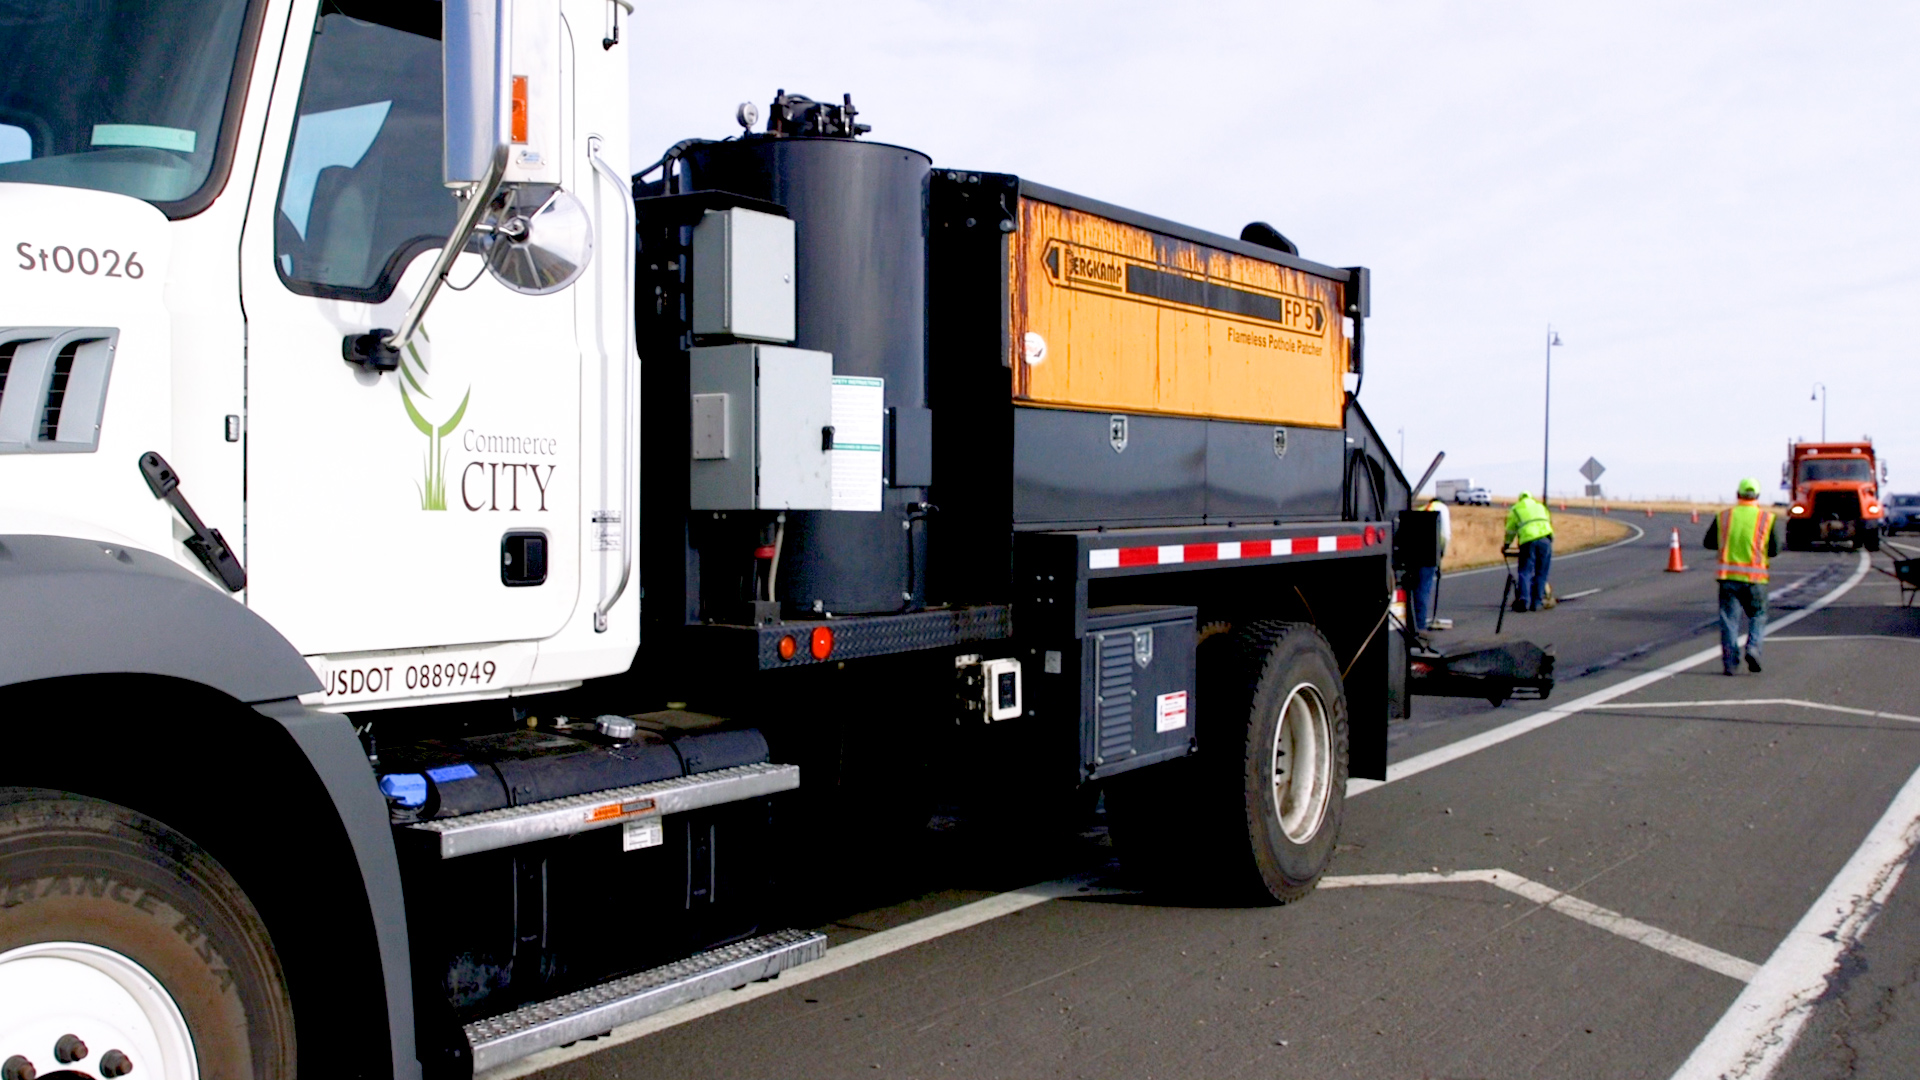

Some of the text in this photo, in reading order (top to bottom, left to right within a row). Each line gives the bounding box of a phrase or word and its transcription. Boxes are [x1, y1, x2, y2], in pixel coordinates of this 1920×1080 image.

[16, 241, 144, 280] St0026
[1285, 299, 1314, 330] FP 5
[1228, 327, 1323, 356] Flameless Pothole Patcher
[463, 428, 557, 455] Commerce
[461, 461, 557, 512] CITY
[326, 660, 497, 697] USDOT 0889949
